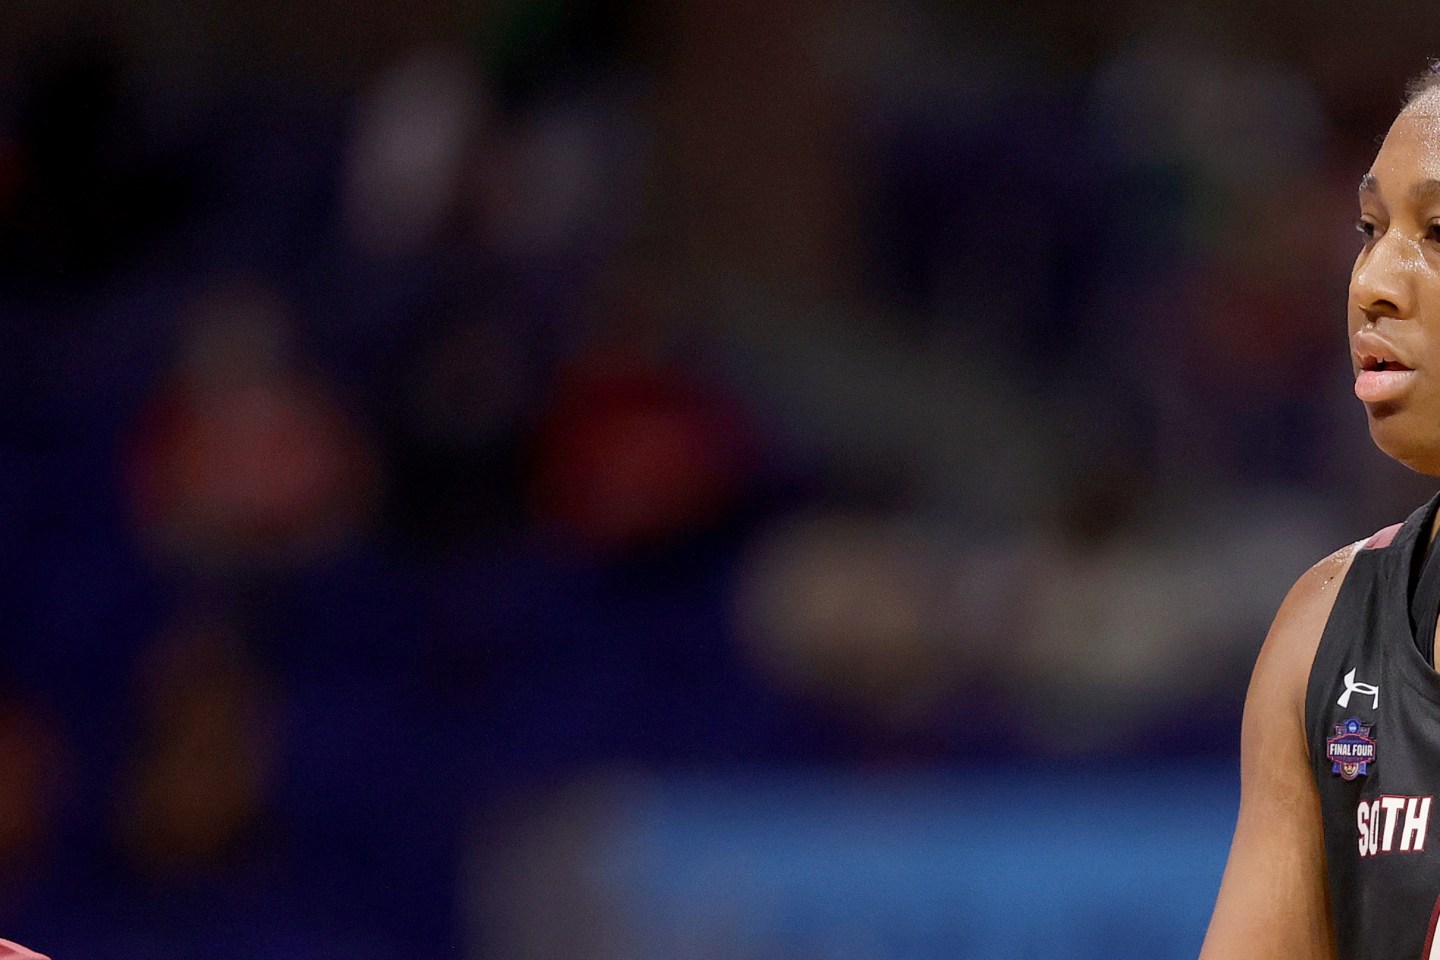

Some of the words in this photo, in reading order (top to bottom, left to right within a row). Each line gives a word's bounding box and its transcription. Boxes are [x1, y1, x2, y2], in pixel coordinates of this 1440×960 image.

[1330, 743, 1351, 756] FINAL
[1352, 744, 1373, 757] FOUR
[1356, 793, 1433, 859] SOTH
